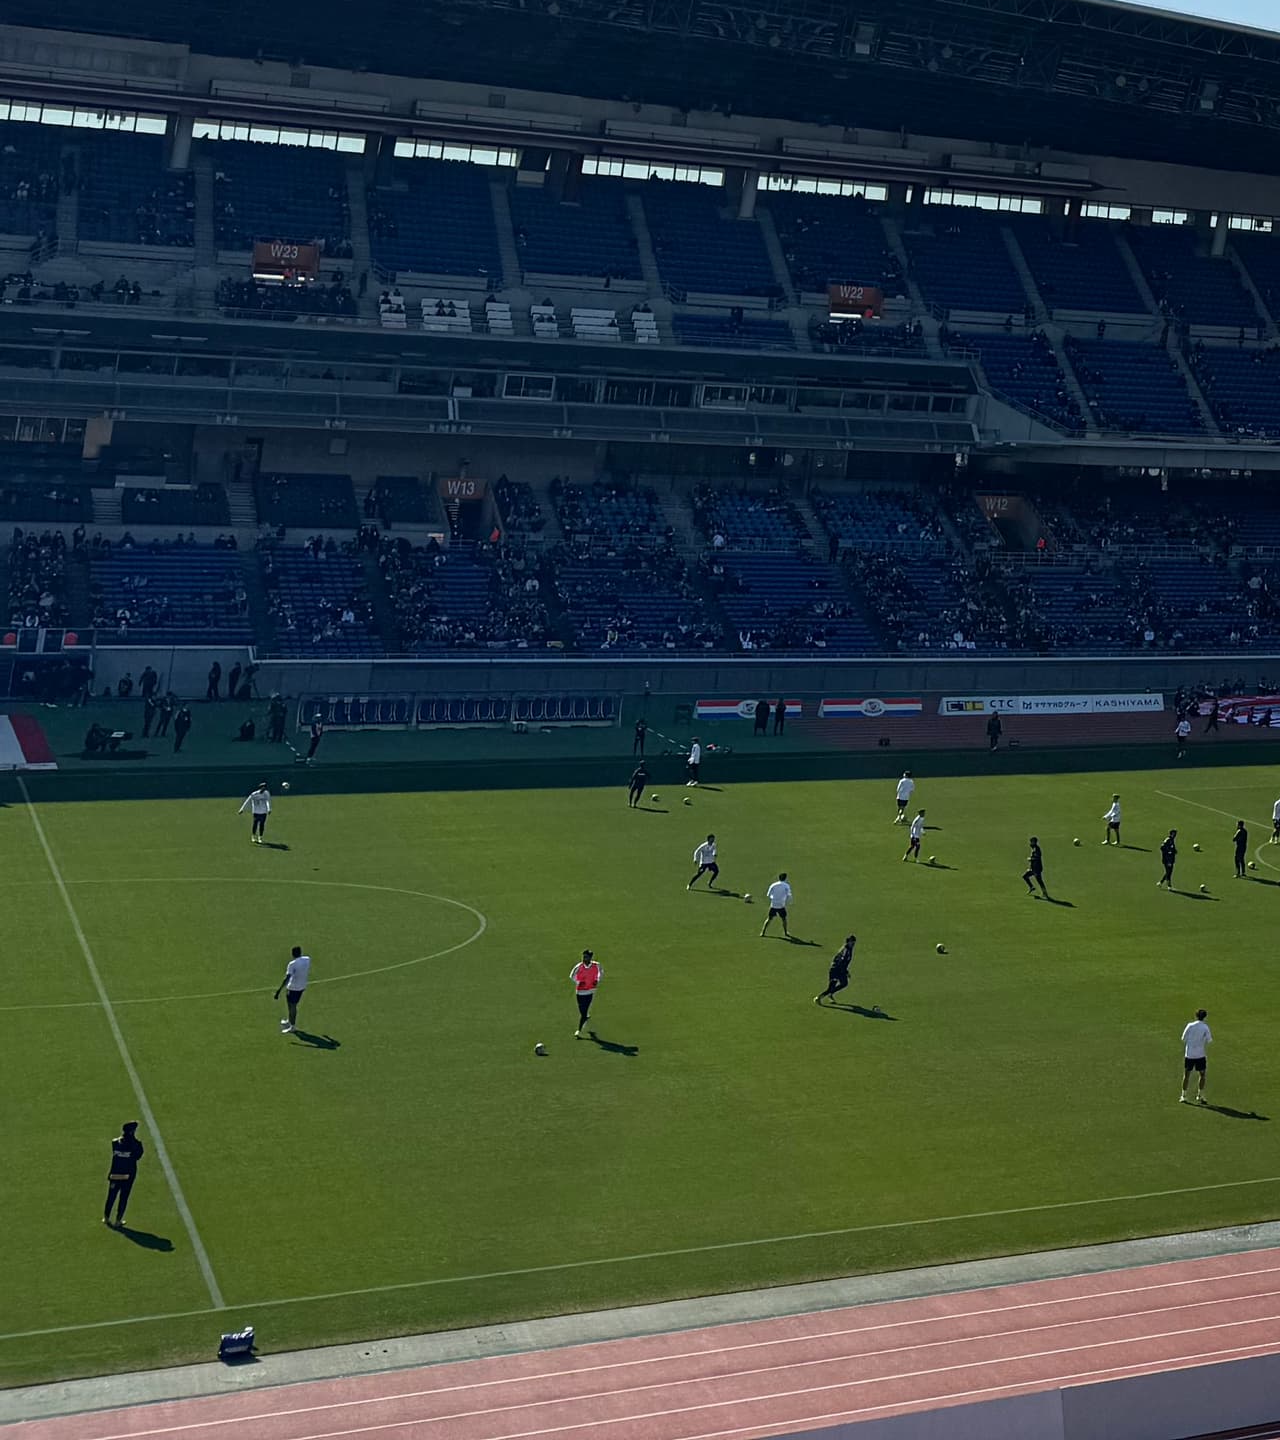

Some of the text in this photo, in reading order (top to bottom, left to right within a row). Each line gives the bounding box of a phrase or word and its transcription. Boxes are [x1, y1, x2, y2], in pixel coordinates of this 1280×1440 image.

[271, 244, 298, 259] W23
[840, 285, 864, 299] W22
[448, 480, 474, 496] W13
[985, 497, 1008, 511] W12
[990, 699, 1014, 708] CTC
[1095, 698, 1160, 708] KASHIYAMA
